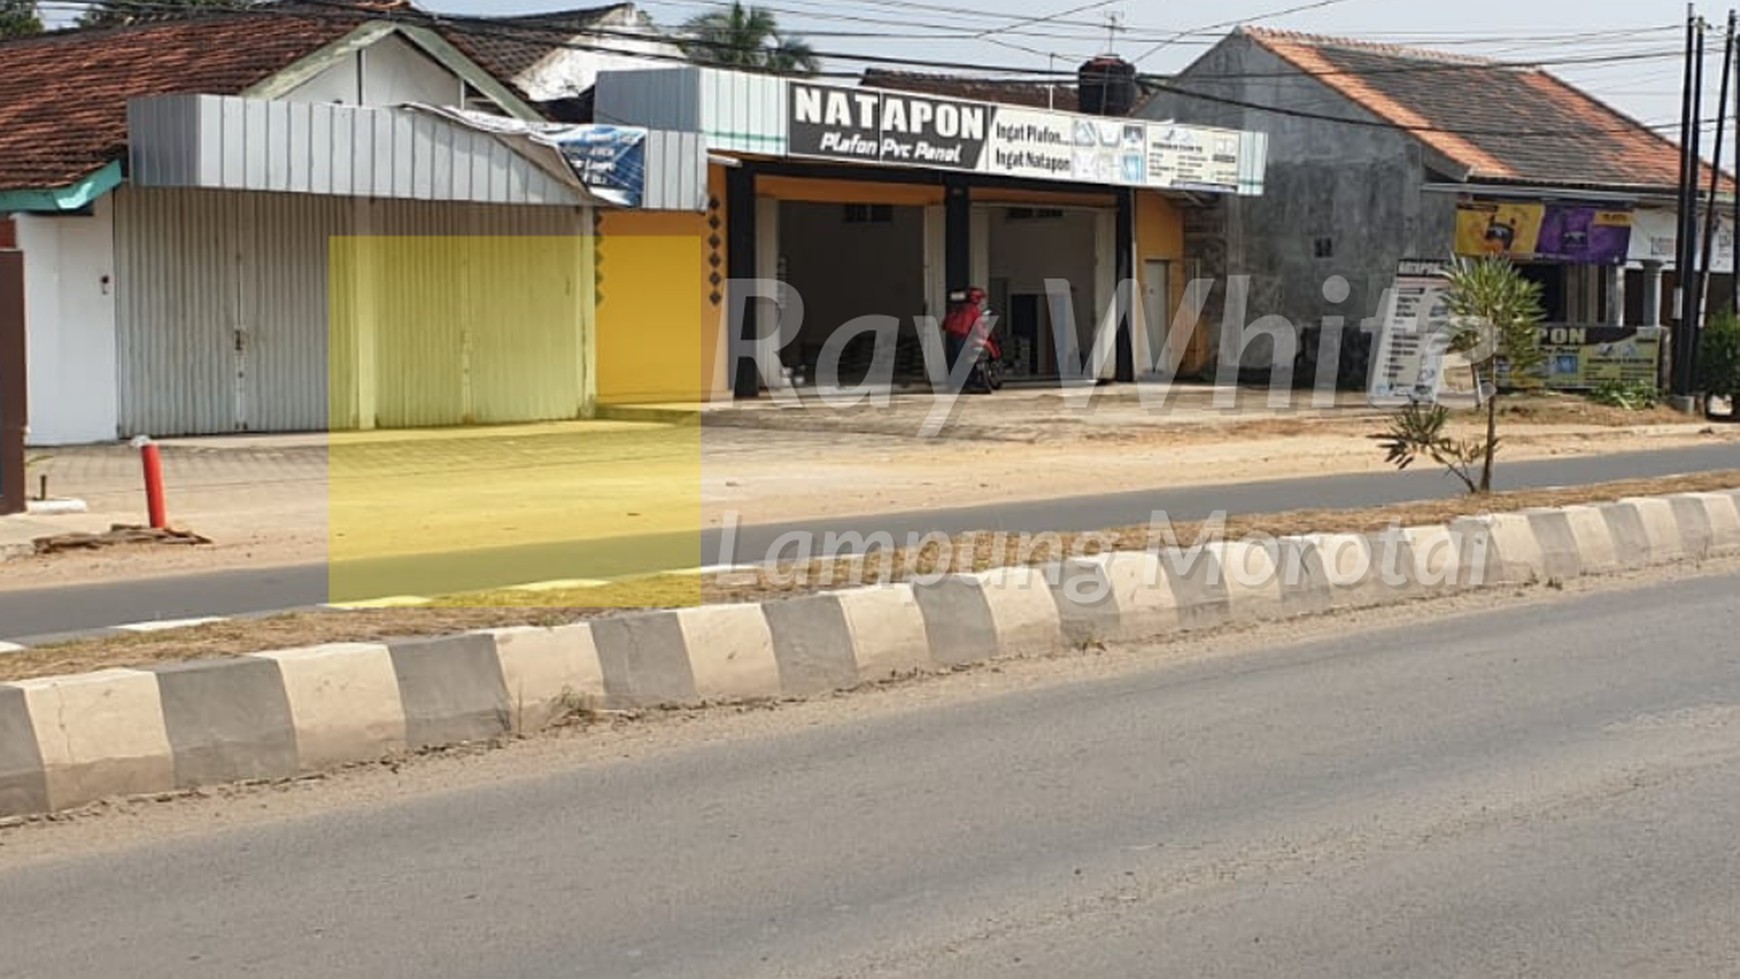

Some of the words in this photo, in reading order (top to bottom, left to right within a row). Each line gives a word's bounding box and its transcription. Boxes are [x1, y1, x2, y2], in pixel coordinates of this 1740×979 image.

[795, 87, 983, 140] NATAPON
[997, 121, 1024, 142] Ingat
[819, 132, 877, 155] Plafon
[914, 141, 962, 163] Panel
[996, 148, 1024, 170] Ingat
[1026, 150, 1071, 174] Natapon
